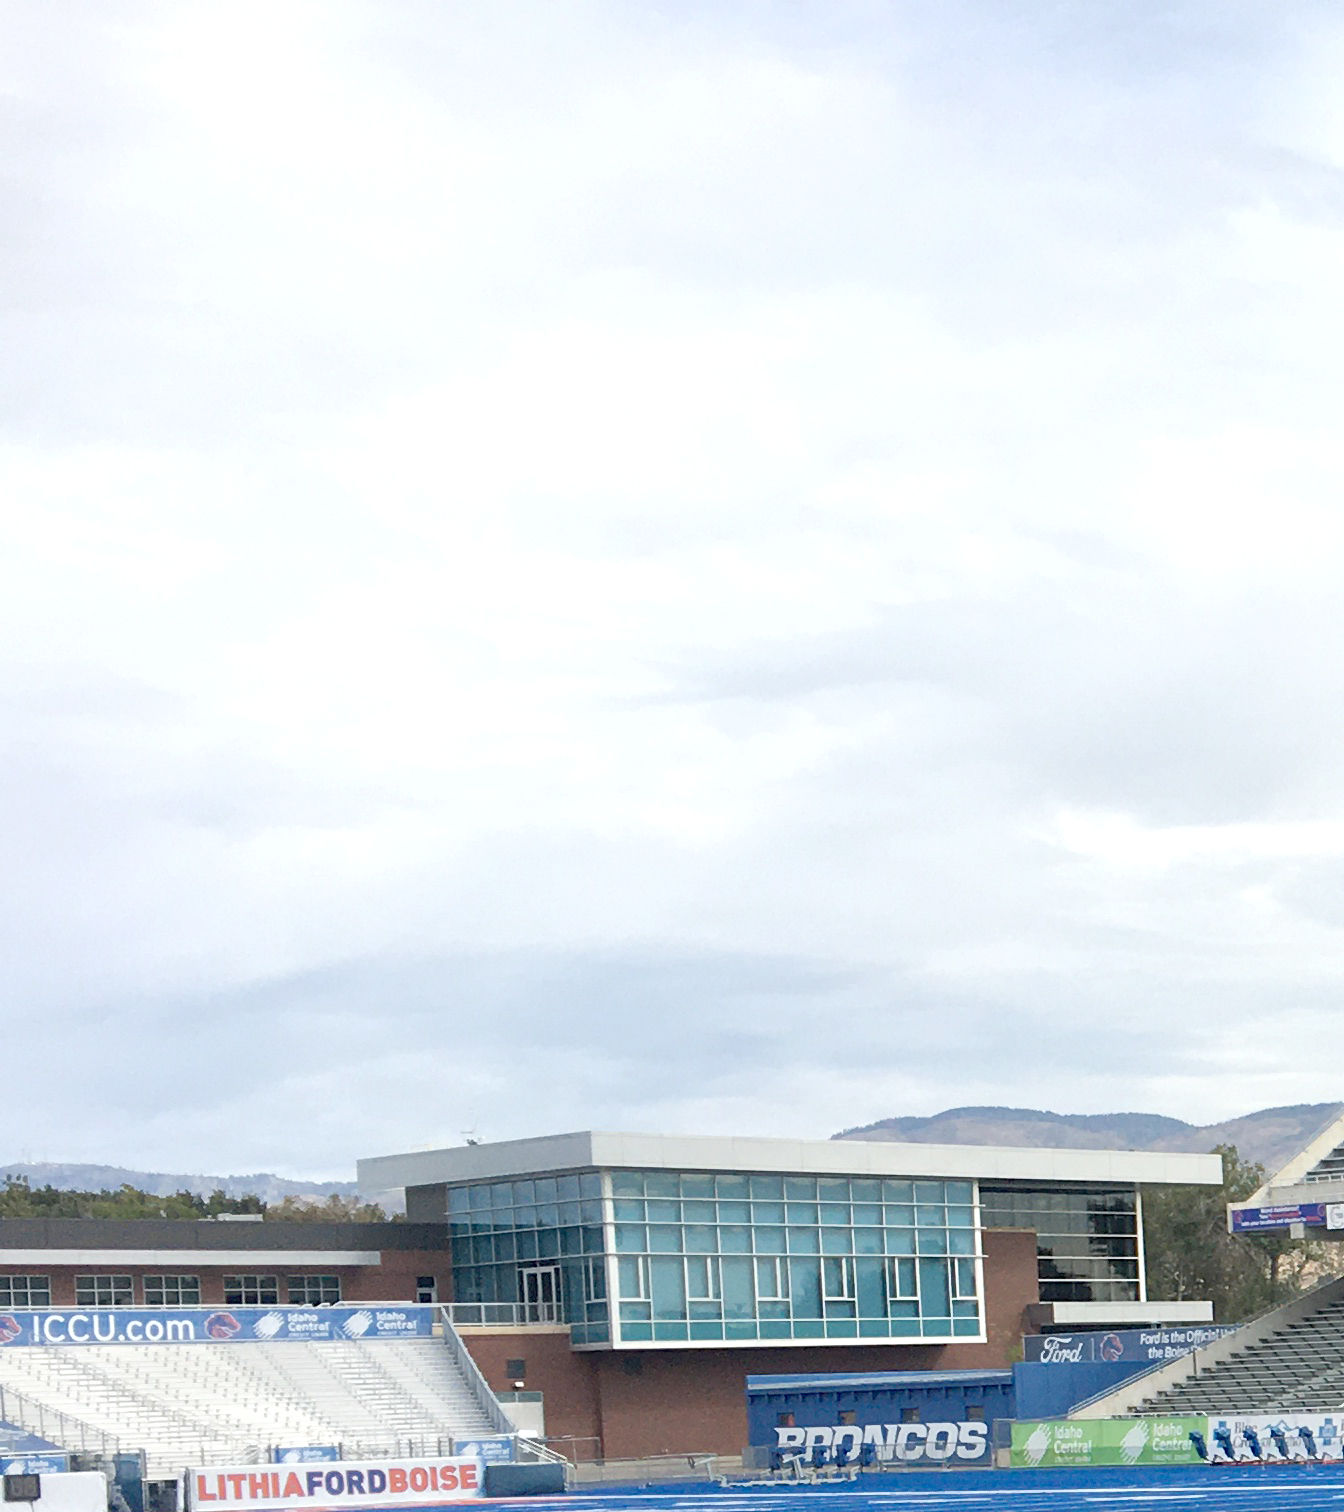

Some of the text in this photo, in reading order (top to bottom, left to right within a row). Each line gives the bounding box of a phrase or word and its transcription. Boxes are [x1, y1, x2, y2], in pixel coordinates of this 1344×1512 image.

[32, 1314, 195, 1342] ICCU.com
[1140, 1333, 1161, 1345] Ford
[1040, 1336, 1084, 1363] Ford
[773, 1421, 988, 1462] BRONCOS
[198, 1464, 478, 1501] LITHIAFORDBOISE
